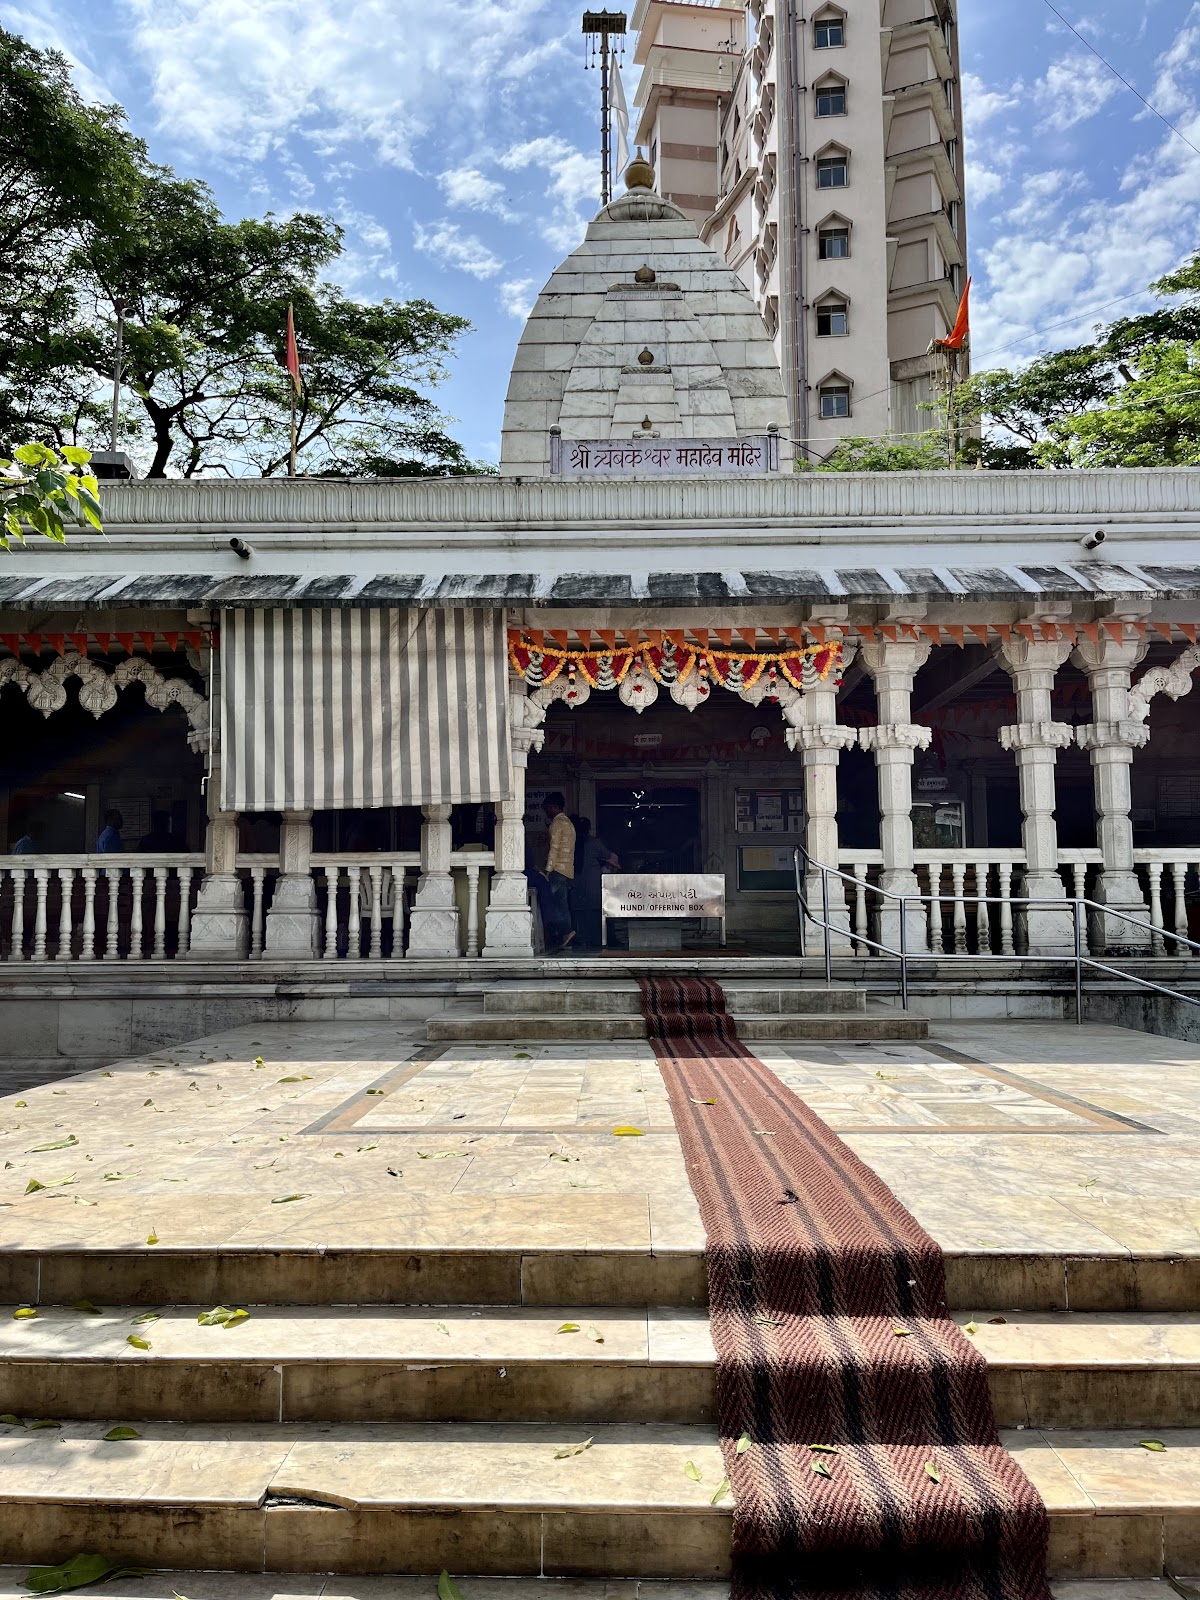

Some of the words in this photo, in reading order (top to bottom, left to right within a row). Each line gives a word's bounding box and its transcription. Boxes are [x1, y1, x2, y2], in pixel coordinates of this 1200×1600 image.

[570, 444, 592, 469] श्री
[676, 443, 723, 467] महादेव
[727, 442, 761, 467] मंदिर
